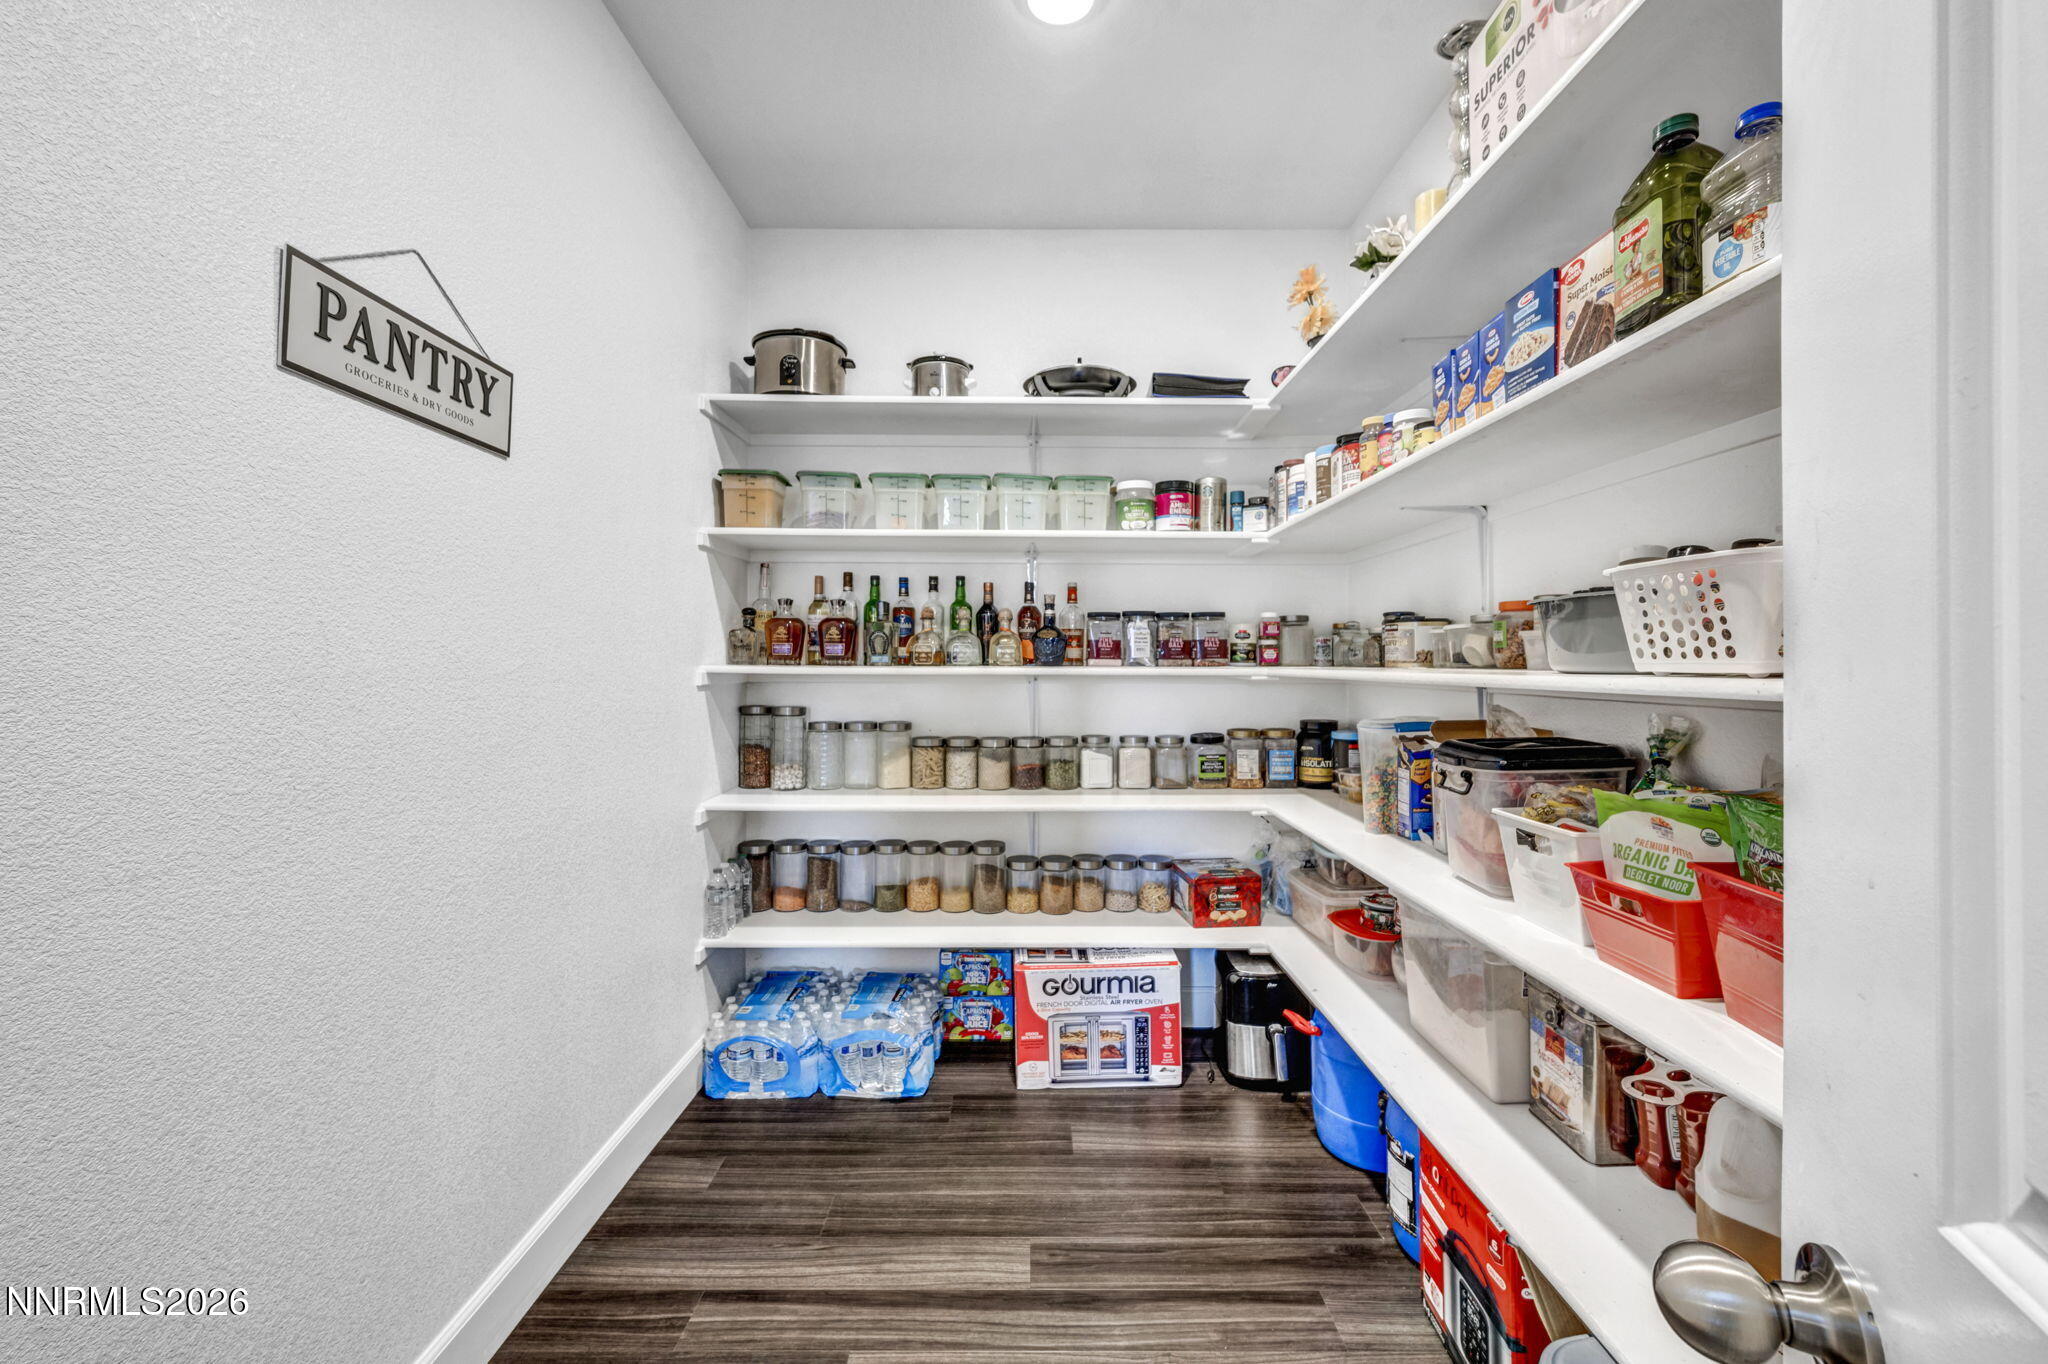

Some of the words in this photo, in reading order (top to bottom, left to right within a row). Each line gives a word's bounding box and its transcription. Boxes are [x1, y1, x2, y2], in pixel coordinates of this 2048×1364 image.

[1474, 22, 1536, 112] SUPERIOR
[1567, 281, 1589, 303] Super
[1590, 264, 1614, 286] Moist
[314, 281, 500, 417] PANTRY
[344, 362, 410, 398] GROCERIES
[411, 394, 420, 403] &
[422, 397, 442, 413] DRY
[444, 407, 475, 427] GOODS
[1634, 838, 1669, 854] PREMIUM
[1625, 867, 1660, 885] DEGLET
[1661, 878, 1689, 893] NOOR
[964, 976, 987, 984] JUICE
[965, 1020, 989, 1029] JUICE
